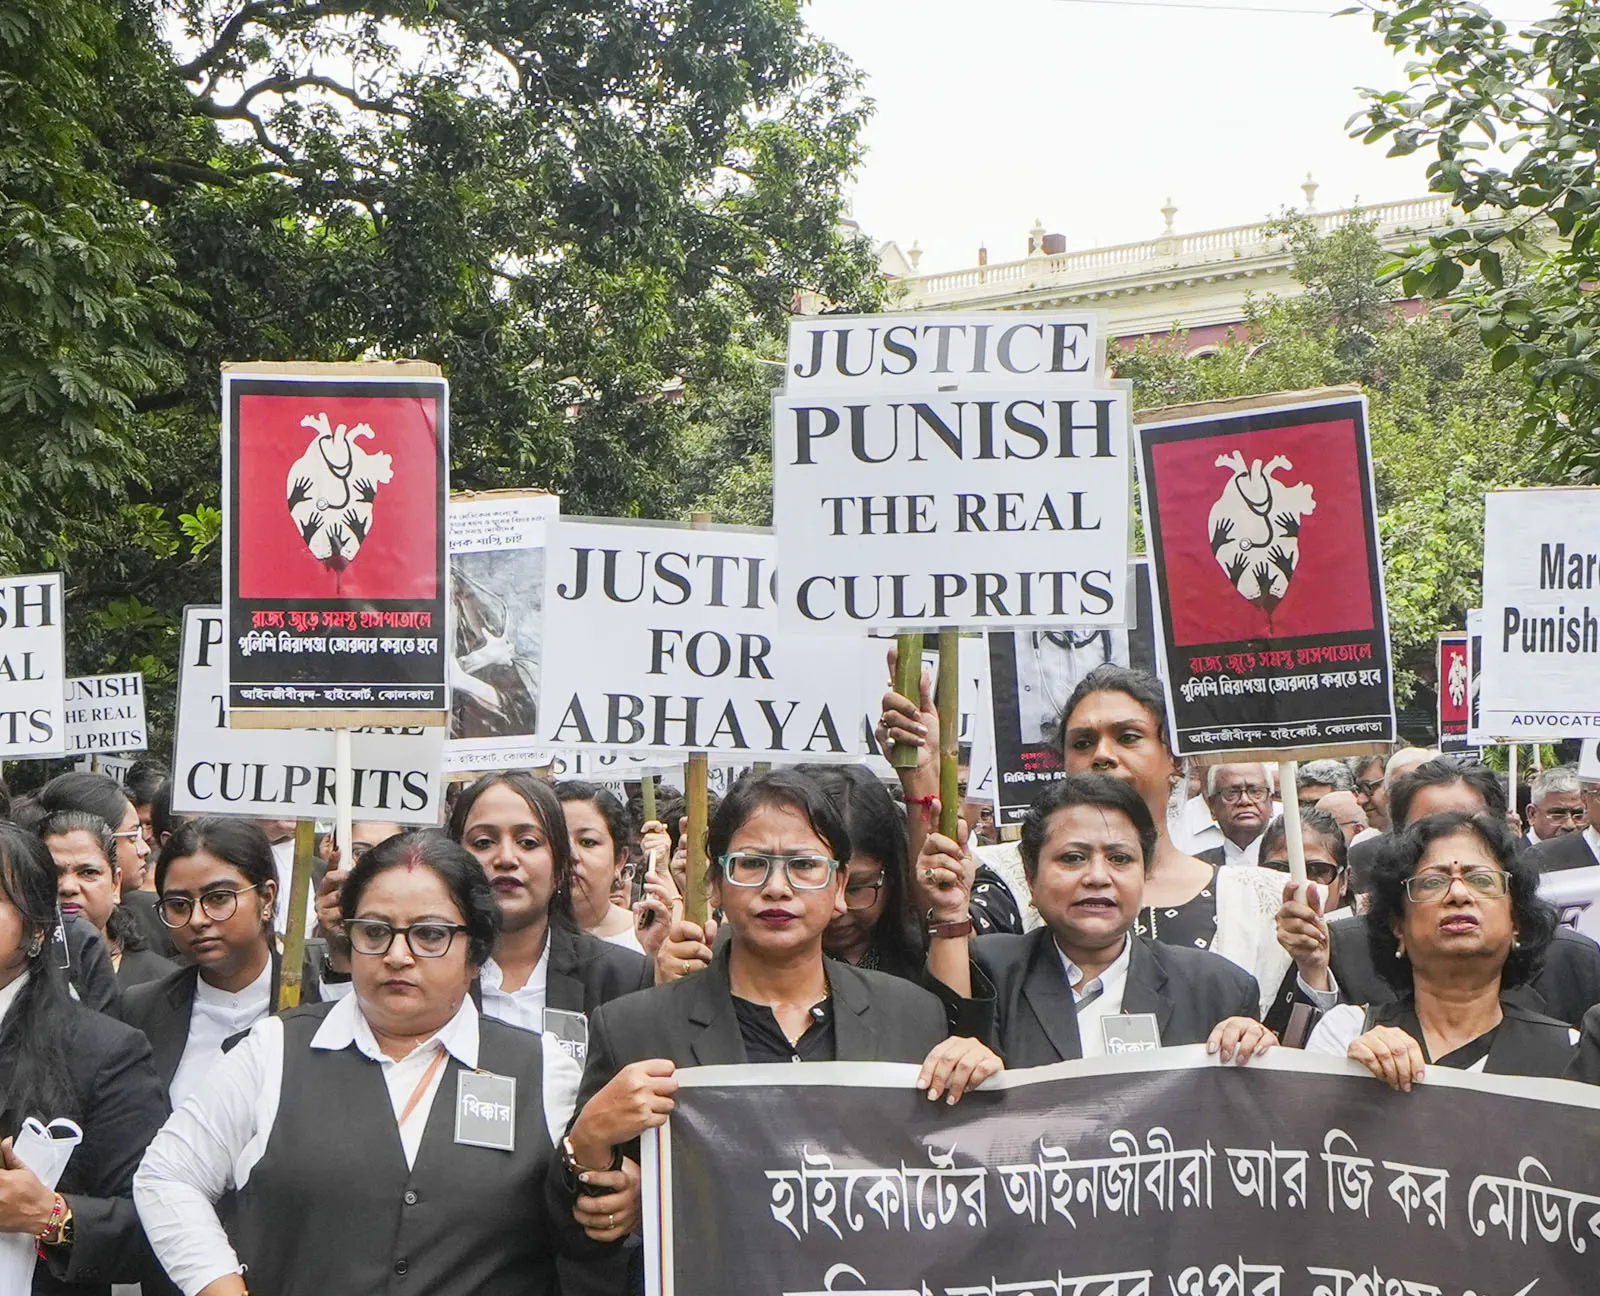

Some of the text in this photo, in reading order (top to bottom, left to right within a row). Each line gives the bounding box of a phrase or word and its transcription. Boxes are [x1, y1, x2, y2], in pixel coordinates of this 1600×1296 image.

[793, 323, 1090, 378] JUSTICE
[789, 399, 1118, 465] PUNISH
[821, 491, 1101, 536] THE REAL
[796, 570, 1114, 621] CULPRITS
[238, 630, 277, 656] পুলিশি
[328, 637, 377, 654] জোরদার
[380, 637, 415, 655] করতে
[416, 637, 439, 655] হবে
[252, 611, 432, 632] রাজ্য জুড়ে সমস্ত হাসপাতালে
[1503, 606, 1598, 654] Punish
[646, 628, 775, 680] FOR
[1189, 643, 1373, 676] রাজ্য জুড়ে সমস্ত হাসপাতালে
[377, 689, 434, 701] কোলকাতা
[1180, 676, 1219, 702] পুলিশি
[1268, 673, 1319, 695] জোরদার
[1321, 670, 1357, 689] করতে
[1359, 668, 1382, 686] হবে
[91, 706, 137, 721] REAL
[550, 691, 848, 753] ABHAYA
[1325, 721, 1383, 736] কোলকাতা
[187, 761, 429, 811] CULPRITS
[461, 1094, 511, 1122] ধিক্কার
[764, 1142, 988, 1241] হাইকোর্টের
[996, 1126, 1216, 1230] আইনজীবীরা
[1225, 1140, 1309, 1211] আর
[1320, 1128, 1375, 1218] জি
[1382, 1160, 1450, 1230] কর
